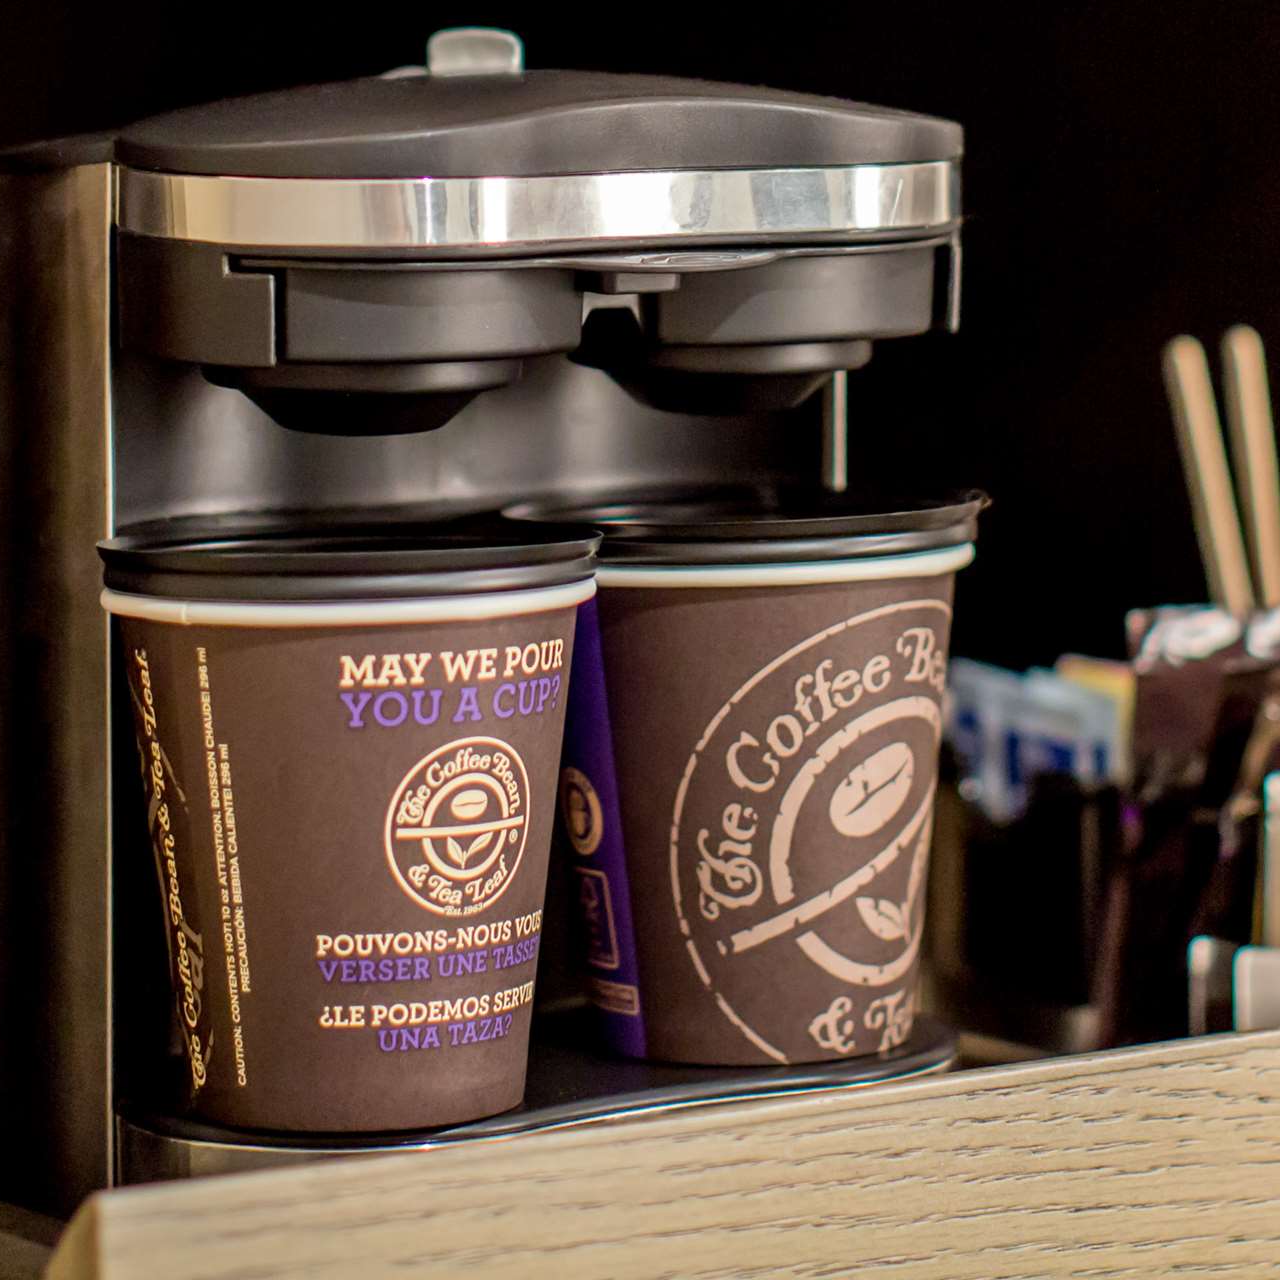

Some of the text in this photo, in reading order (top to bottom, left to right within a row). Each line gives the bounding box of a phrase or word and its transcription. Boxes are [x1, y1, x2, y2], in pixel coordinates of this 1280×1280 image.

[339, 638, 563, 687] MAY WE POUR
[200, 691, 215, 748] CHAUDE!
[339, 673, 561, 728] YOU A CUP?
[726, 655, 891, 793] Coffee
[150, 741, 165, 800] Tea
[207, 751, 220, 809] BOISSON
[396, 784, 431, 825] The
[426, 747, 492, 788] Coffee
[492, 752, 521, 815] Bean
[222, 788, 238, 853] CALIENTE!
[163, 833, 184, 926] Bean
[230, 856, 243, 904] BEBIDA
[408, 854, 508, 905] & Tea Leaf
[697, 803, 763, 921] The
[222, 920, 234, 953] HOT!
[316, 909, 542, 957] POUVONS-NOUS VOUS
[177, 931, 198, 1028] Coffee
[226, 955, 240, 1024] CONTENTS
[318, 957, 430, 983] VERSER
[437, 950, 487, 977] UNE
[320, 1006, 365, 1028] ¿LE
[371, 995, 490, 1027] PODEMOS
[378, 1014, 513, 1052] UNA TAZA?
[808, 996, 856, 1053] &
[233, 1025, 247, 1087] CAUTION:
